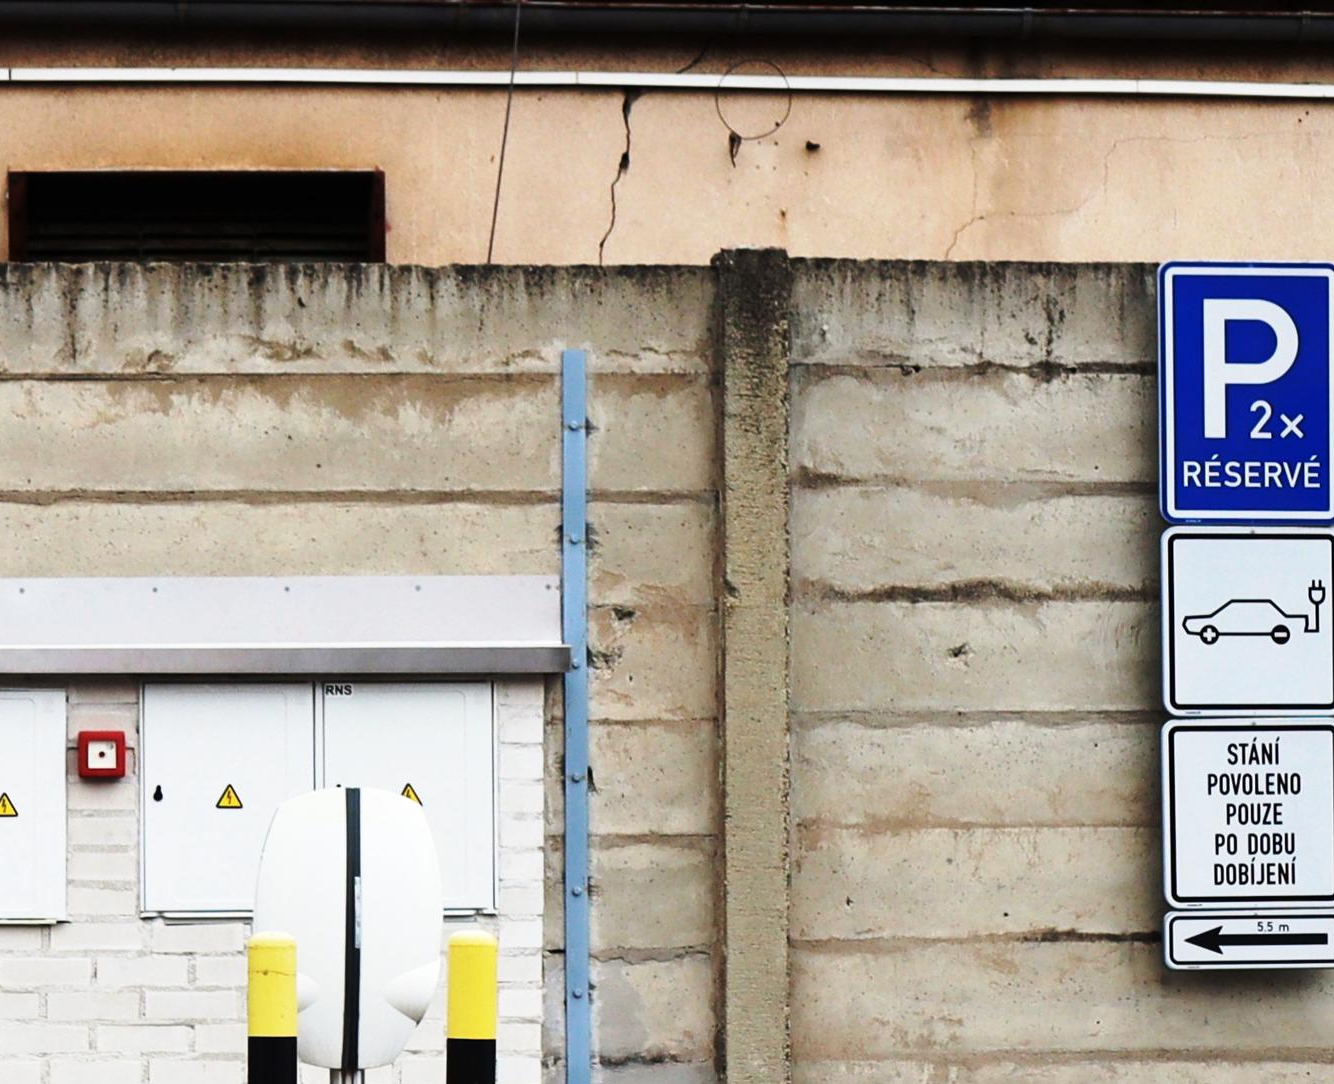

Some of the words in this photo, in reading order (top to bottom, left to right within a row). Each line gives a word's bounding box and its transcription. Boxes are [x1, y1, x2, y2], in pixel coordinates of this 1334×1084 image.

[1202, 298, 1299, 439] P
[1182, 453, 1322, 489] RÉSERVÉ
[325, 684, 353, 696] RNS
[1226, 736, 1280, 766] STÁNÍ
[1207, 772, 1302, 796] POVOLENO
[1225, 802, 1284, 826] POUZE
[1214, 833, 1238, 856] PO
[1247, 832, 1296, 856] DOBU
[1213, 856, 1297, 886] DOBÍJENÍ
[1278, 923, 1290, 932] m
